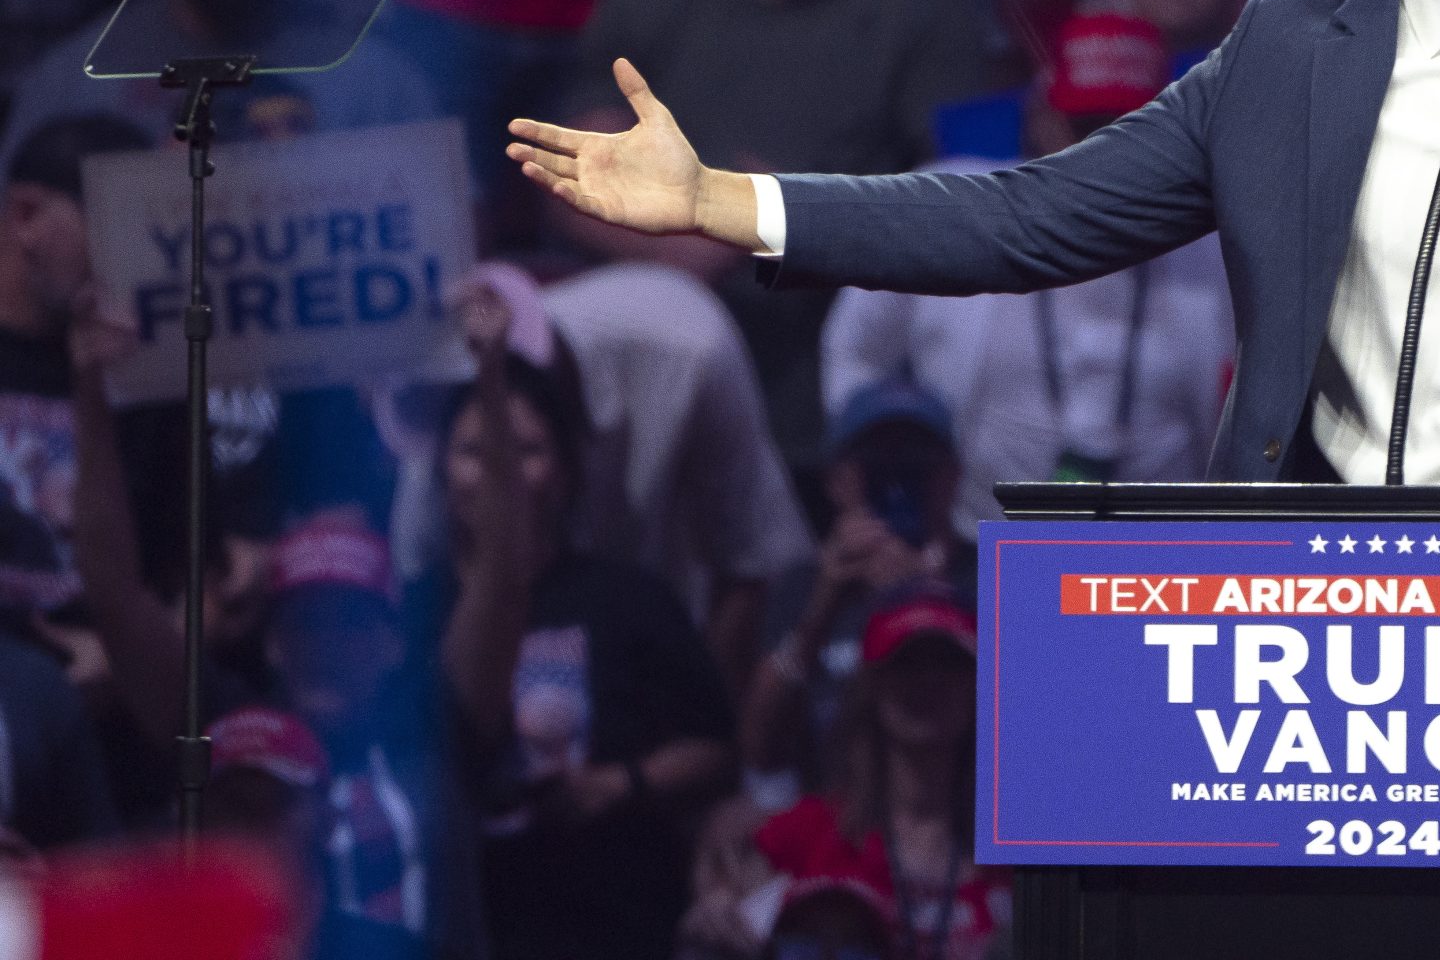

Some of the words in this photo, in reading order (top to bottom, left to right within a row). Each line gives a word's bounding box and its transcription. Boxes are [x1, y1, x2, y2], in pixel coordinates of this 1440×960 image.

[147, 202, 412, 270] YOU'RE
[1080, 577, 1199, 613] TEXT
[1212, 577, 1436, 615] ARIZONA
[1171, 781, 1247, 802] MAKE
[1255, 782, 1378, 804] AMERICA
